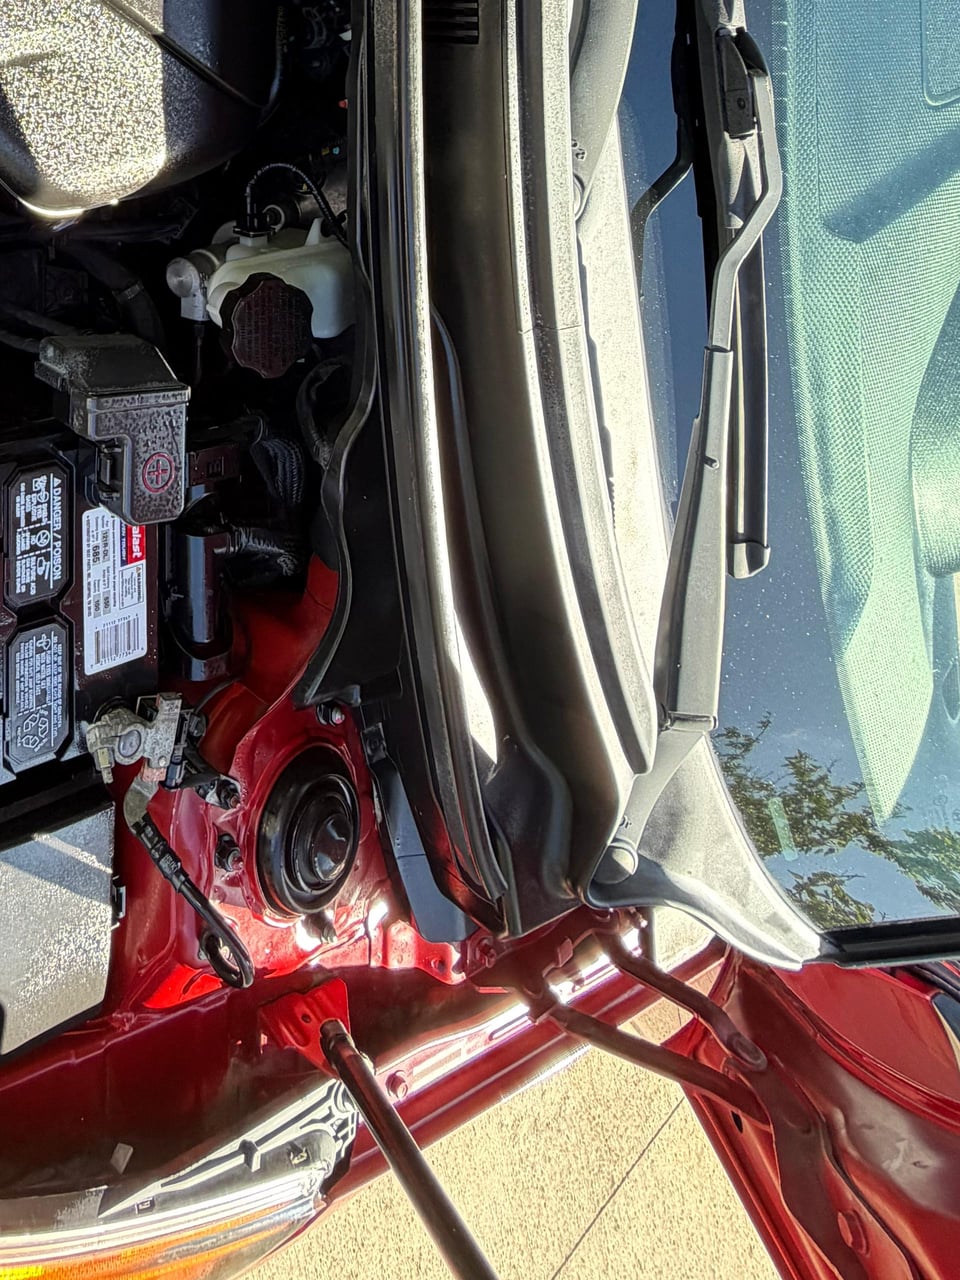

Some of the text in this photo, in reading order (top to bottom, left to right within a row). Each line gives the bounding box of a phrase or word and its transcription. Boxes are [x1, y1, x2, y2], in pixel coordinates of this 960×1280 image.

[54, 488, 62, 530] DANGER
[92, 545, 100, 563] 685
[132, 526, 142, 558] alast
[54, 541, 62, 580] POISON
